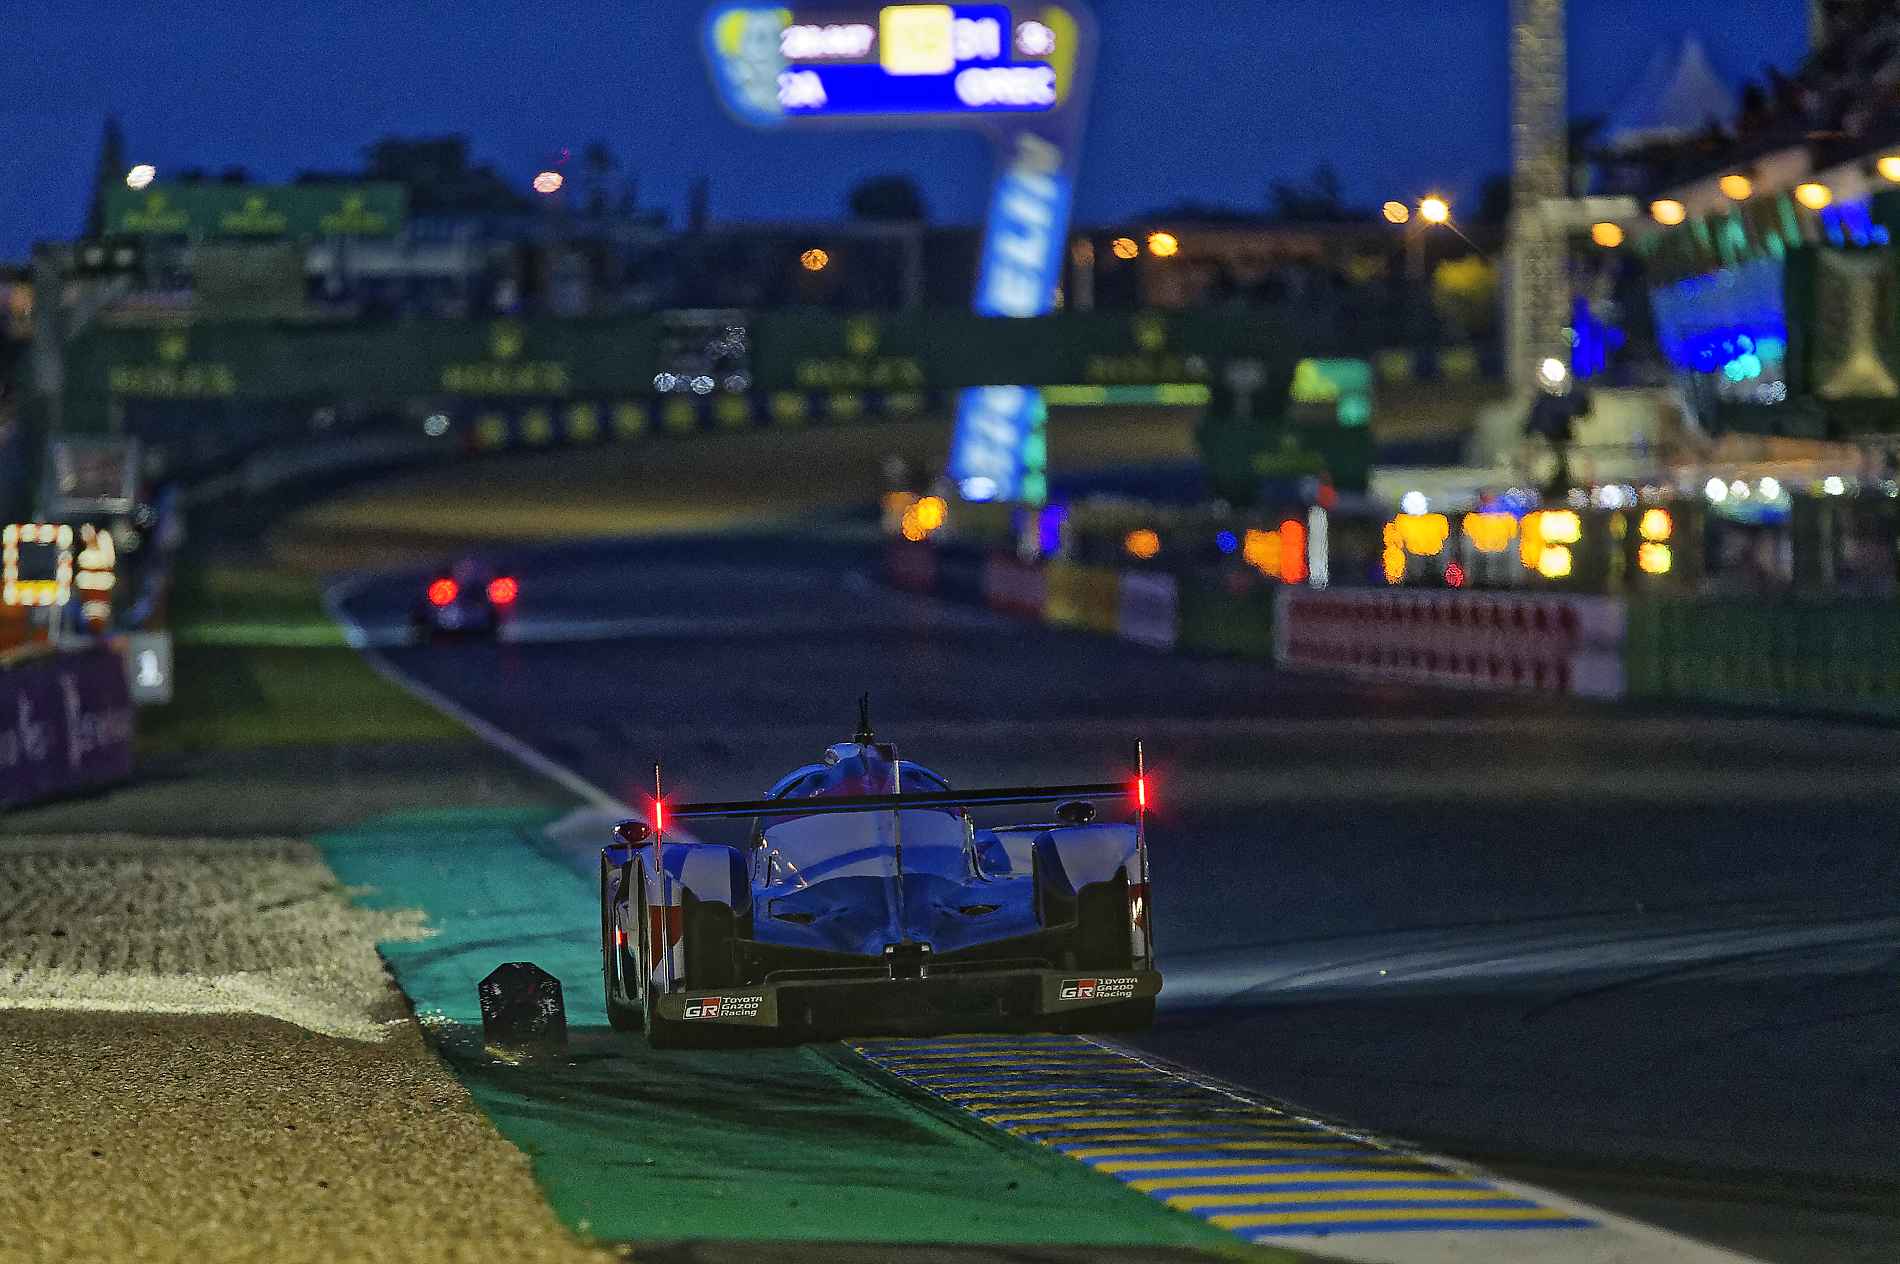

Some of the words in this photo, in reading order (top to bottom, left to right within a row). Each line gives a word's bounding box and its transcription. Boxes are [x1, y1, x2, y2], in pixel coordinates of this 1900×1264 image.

[1098, 977, 1138, 985] TOYOTA
[1061, 986, 1094, 998] GR
[1096, 984, 1134, 992] GAZOO
[1096, 990, 1133, 998] Racing
[722, 996, 763, 1004] TOYOTA
[685, 1005, 718, 1018] GR
[720, 1009, 758, 1017] Racing
